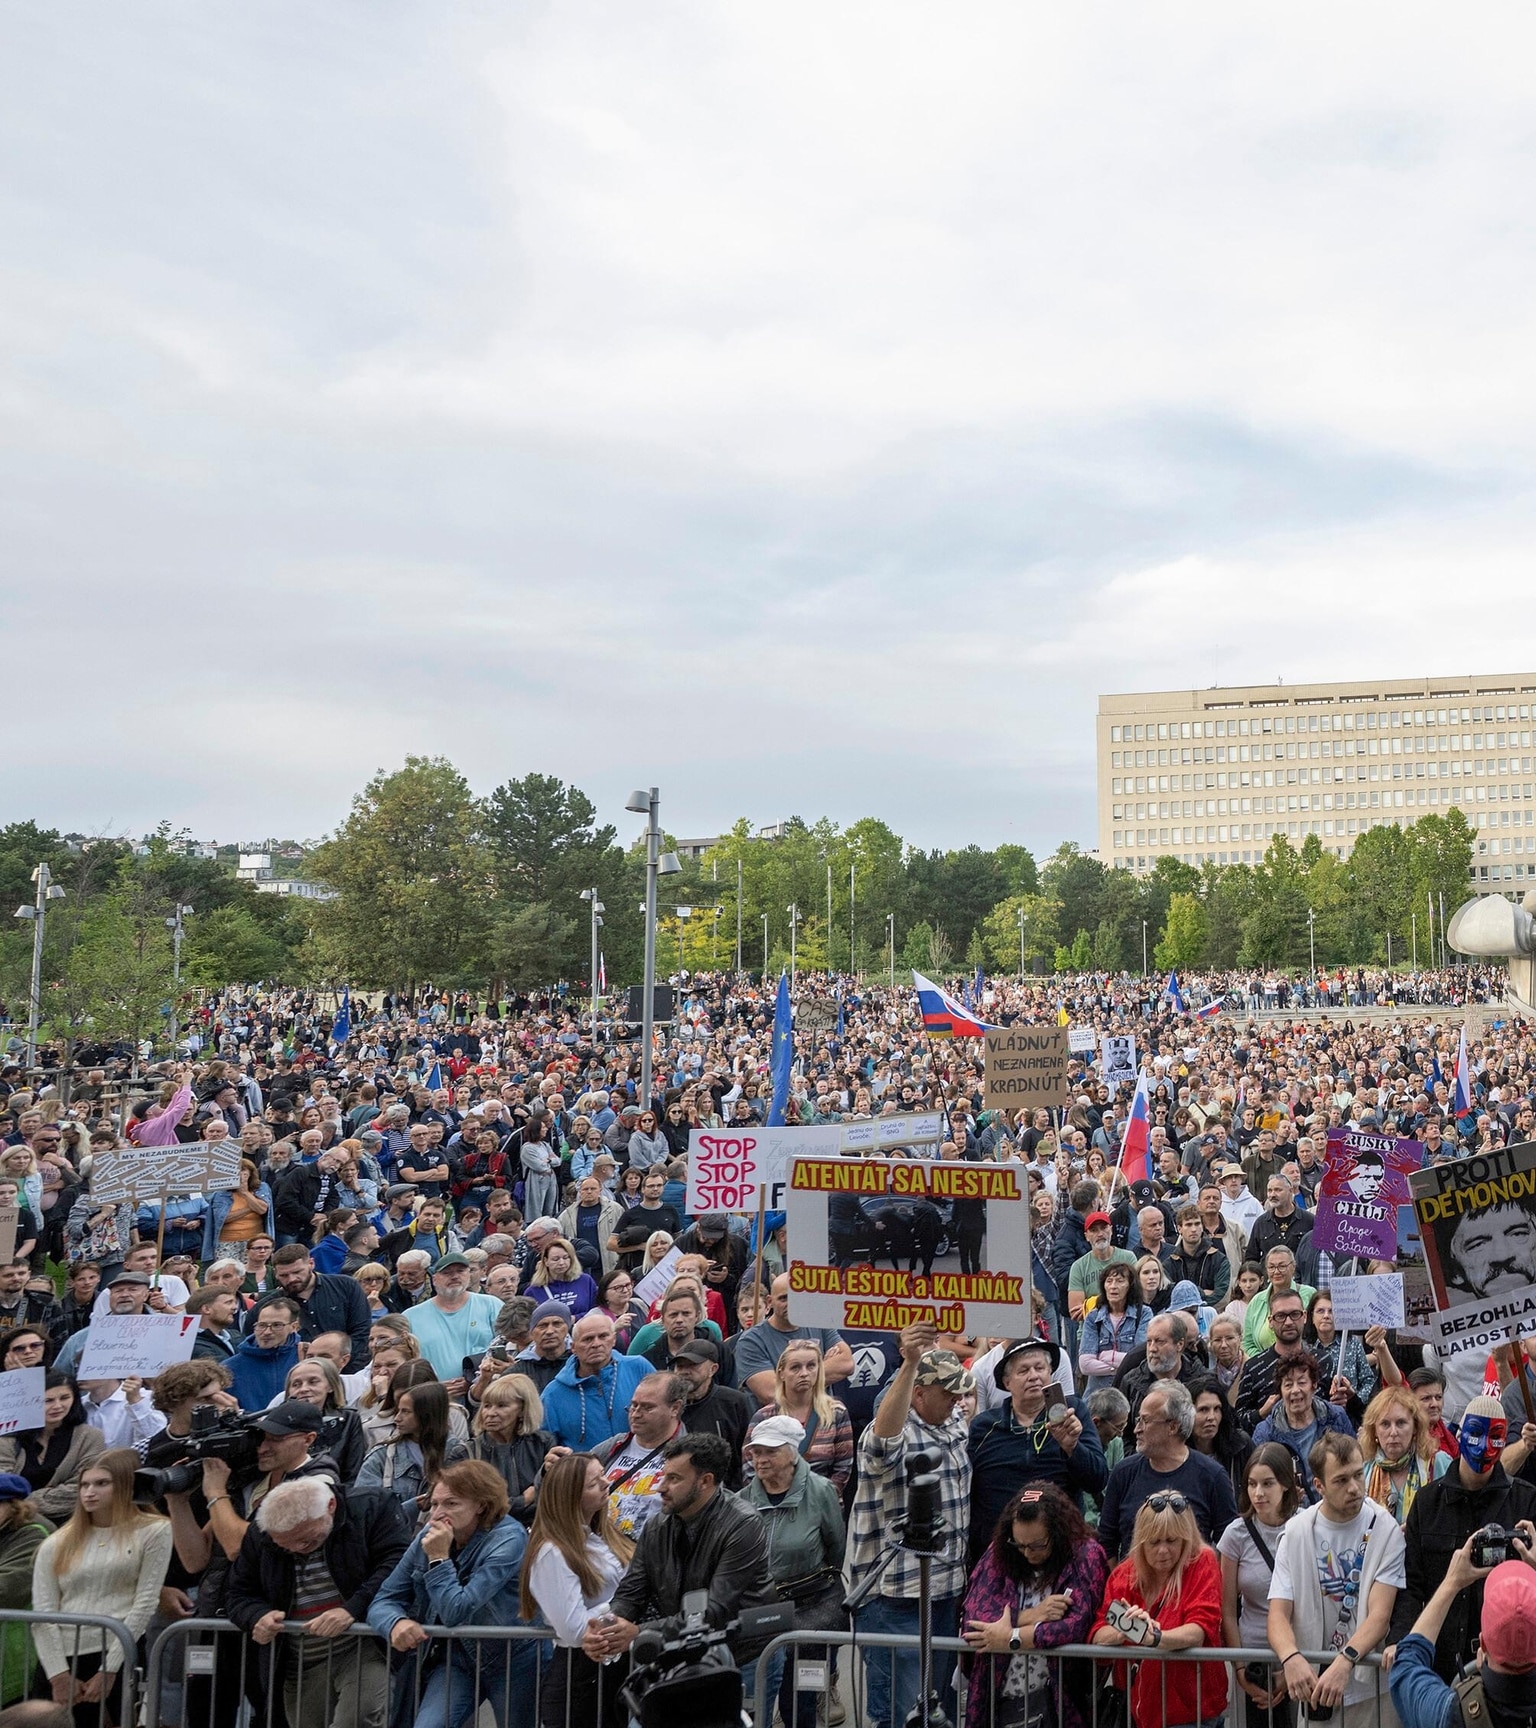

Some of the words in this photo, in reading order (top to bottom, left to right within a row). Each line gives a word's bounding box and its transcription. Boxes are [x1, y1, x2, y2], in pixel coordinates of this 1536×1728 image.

[990, 1073, 1063, 1094] KRADNÚŤ
[140, 1146, 202, 1158] NEZABUDNEME
[696, 1135, 757, 1161] STOP
[695, 1161, 756, 1184] STOP
[793, 1160, 888, 1192] ATENTÁT
[894, 1166, 926, 1195] SA
[932, 1169, 1020, 1199] NESTAL
[1435, 1150, 1518, 1195] PROTI
[694, 1184, 755, 1210] STOP
[1334, 1201, 1387, 1222] CHUJ
[791, 1261, 842, 1293] ŠUTA
[846, 1267, 910, 1298] EŠTOK
[914, 1277, 928, 1298] a
[933, 1273, 1023, 1303] KALIŇÁK
